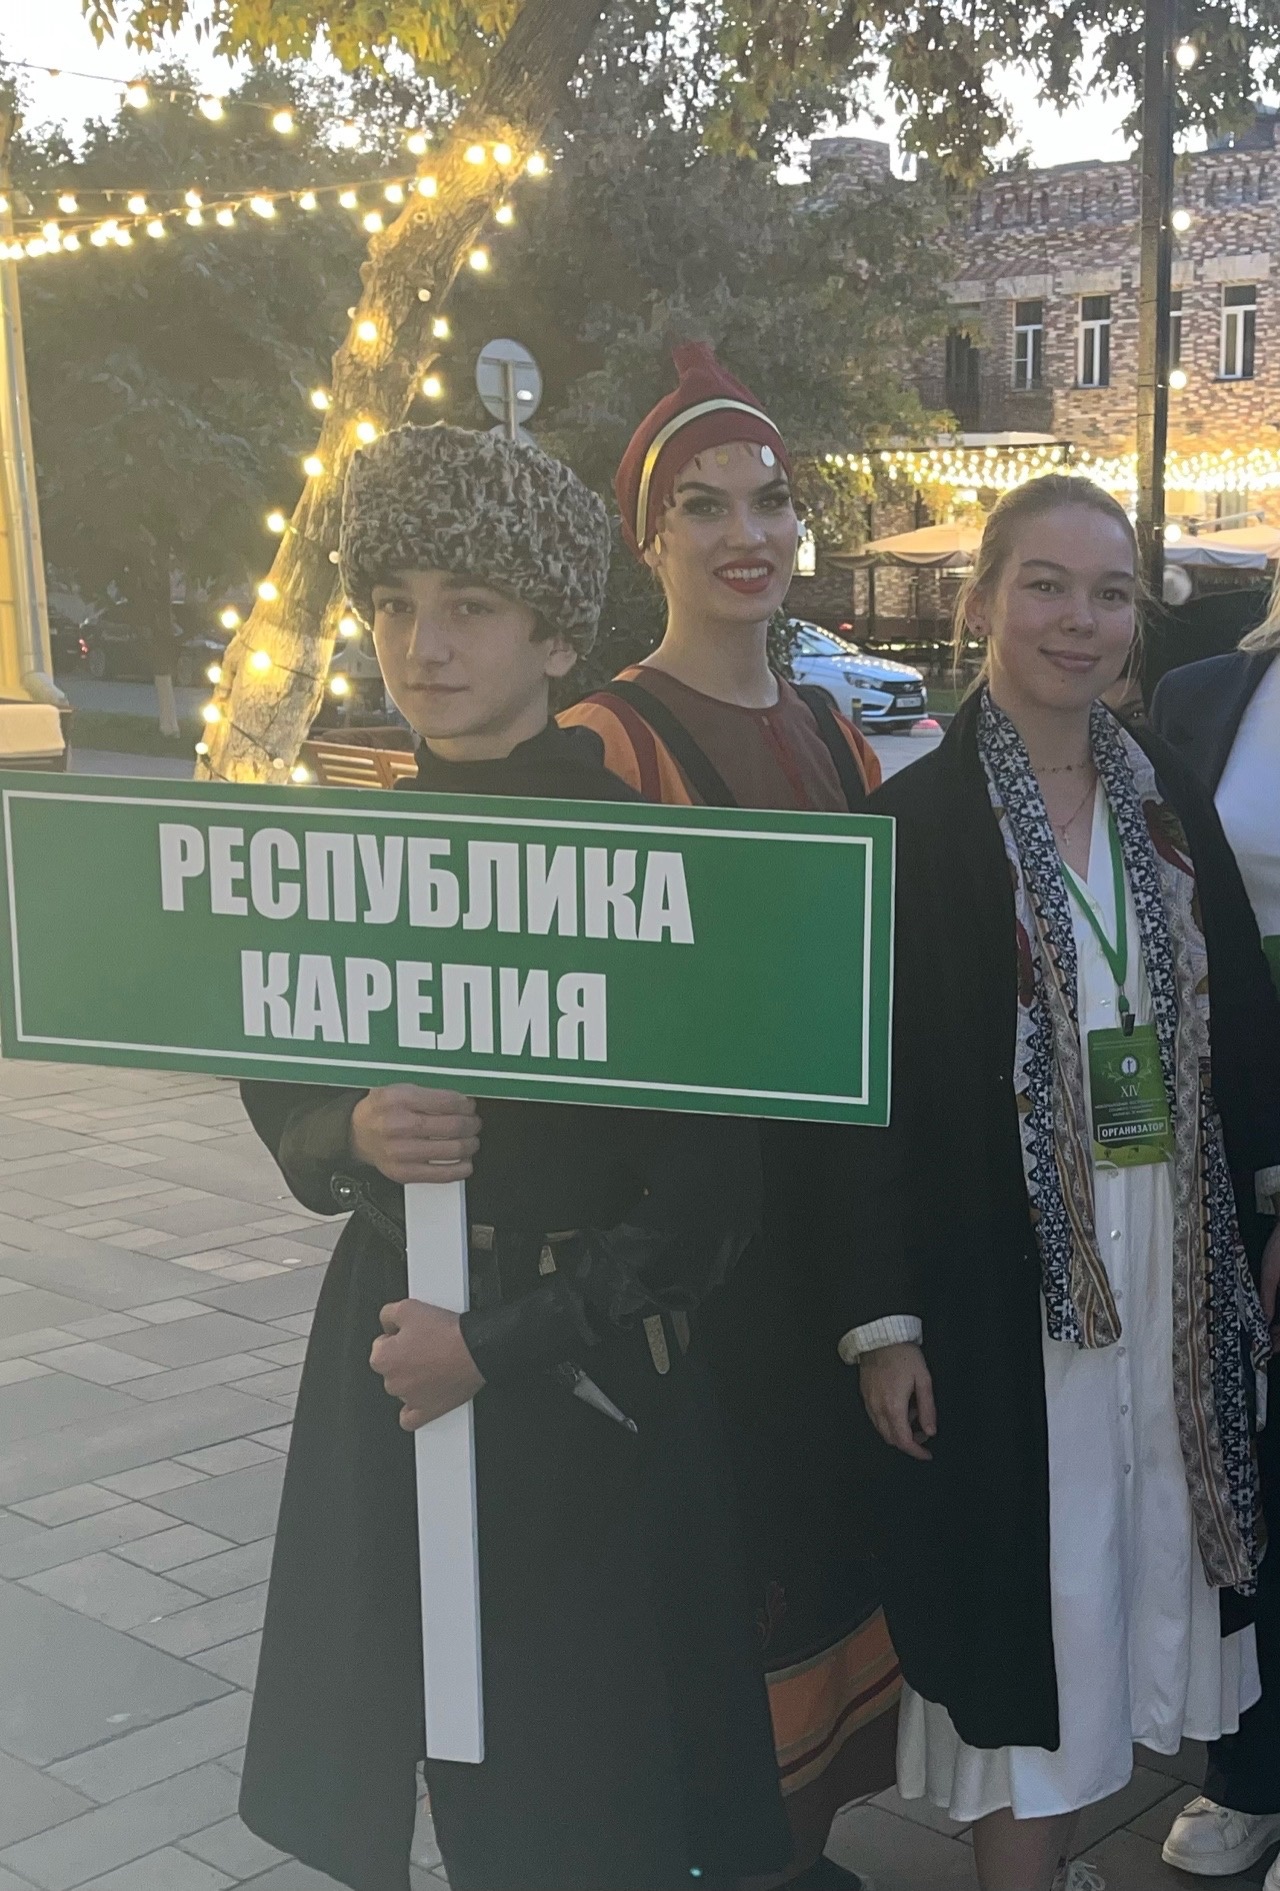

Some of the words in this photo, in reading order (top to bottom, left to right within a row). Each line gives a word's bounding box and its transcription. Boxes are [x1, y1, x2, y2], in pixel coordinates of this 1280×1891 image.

[158, 822, 695, 945] РЕСПУБЛИКА
[240, 950, 609, 1063] КАРЕЛИЯ
[1120, 1082, 1141, 1098] XIV
[1101, 1122, 1164, 1138] ОРГАНИЗАТОР
